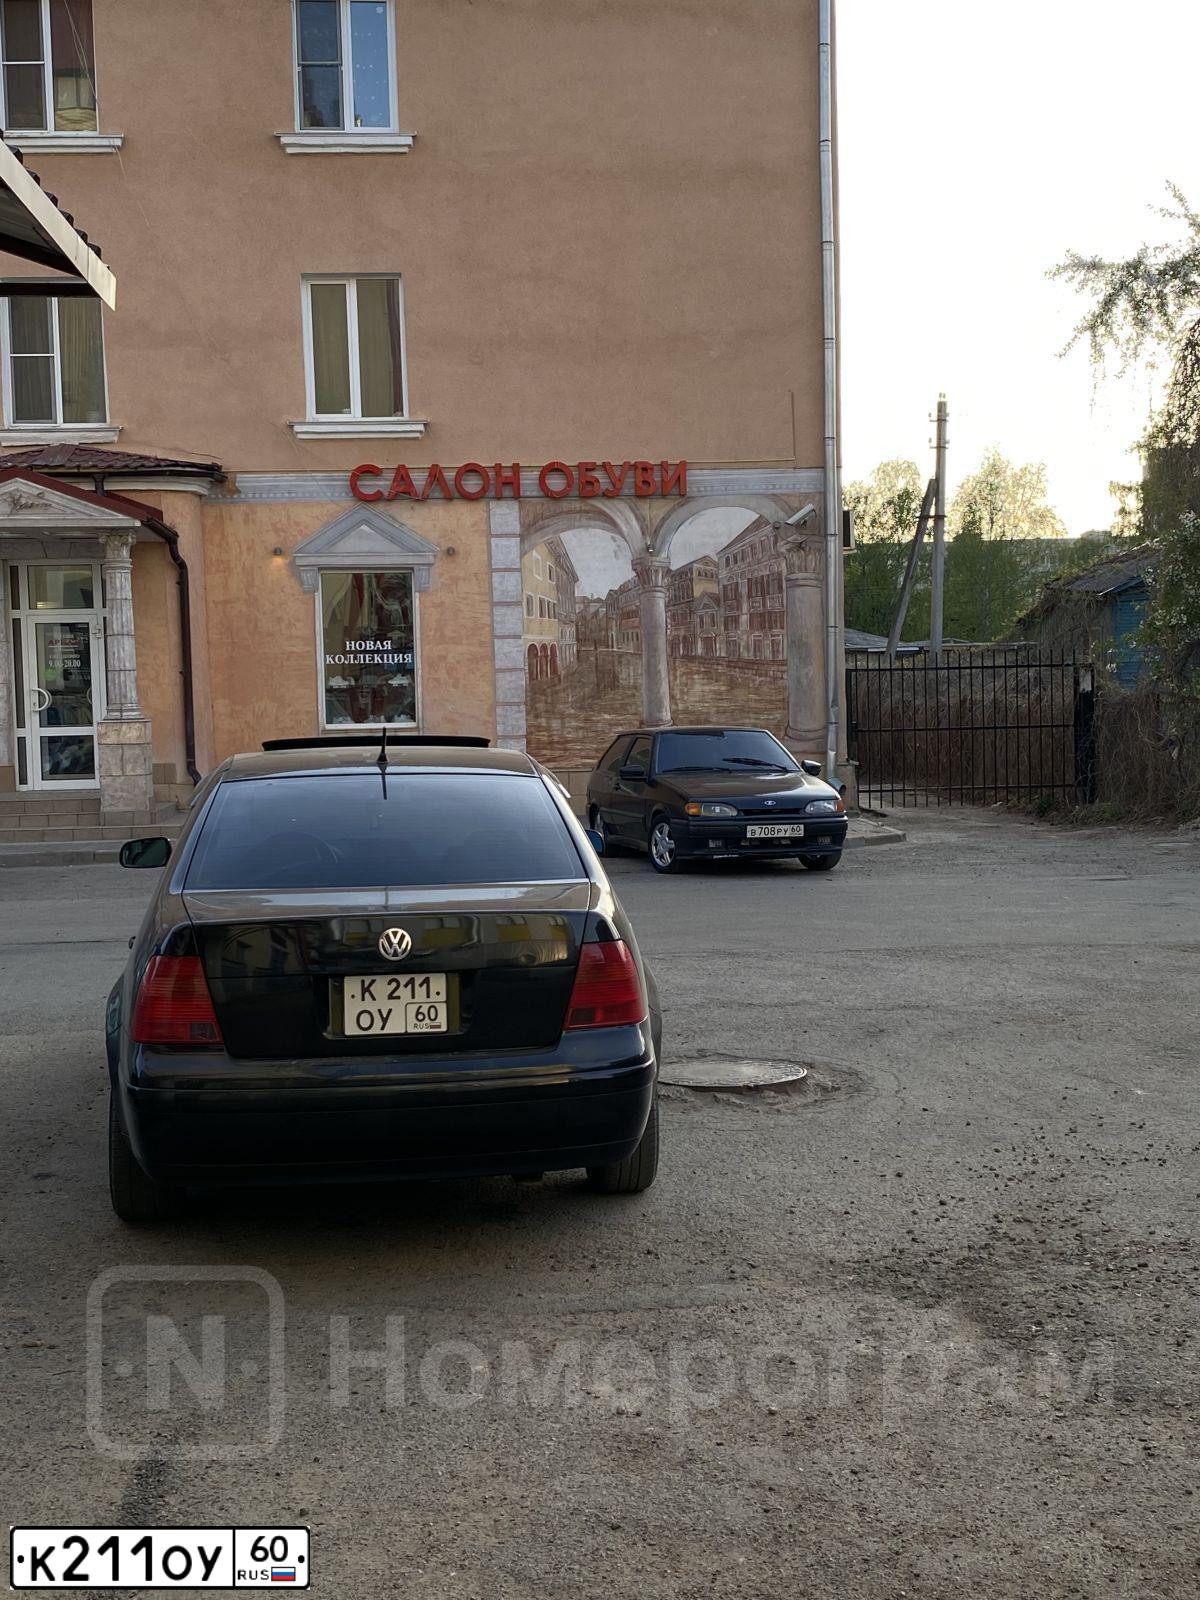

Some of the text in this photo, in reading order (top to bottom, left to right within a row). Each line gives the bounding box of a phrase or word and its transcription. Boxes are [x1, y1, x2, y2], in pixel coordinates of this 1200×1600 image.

[350, 460, 687, 501] САЛОН ОБУВИ
[345, 640, 392, 651] НОВАЯ
[325, 653, 413, 665] КОЛЛЕКЦИЯ
[415, 1004, 439, 1022] 60
[413, 1022, 430, 1030] RUS
